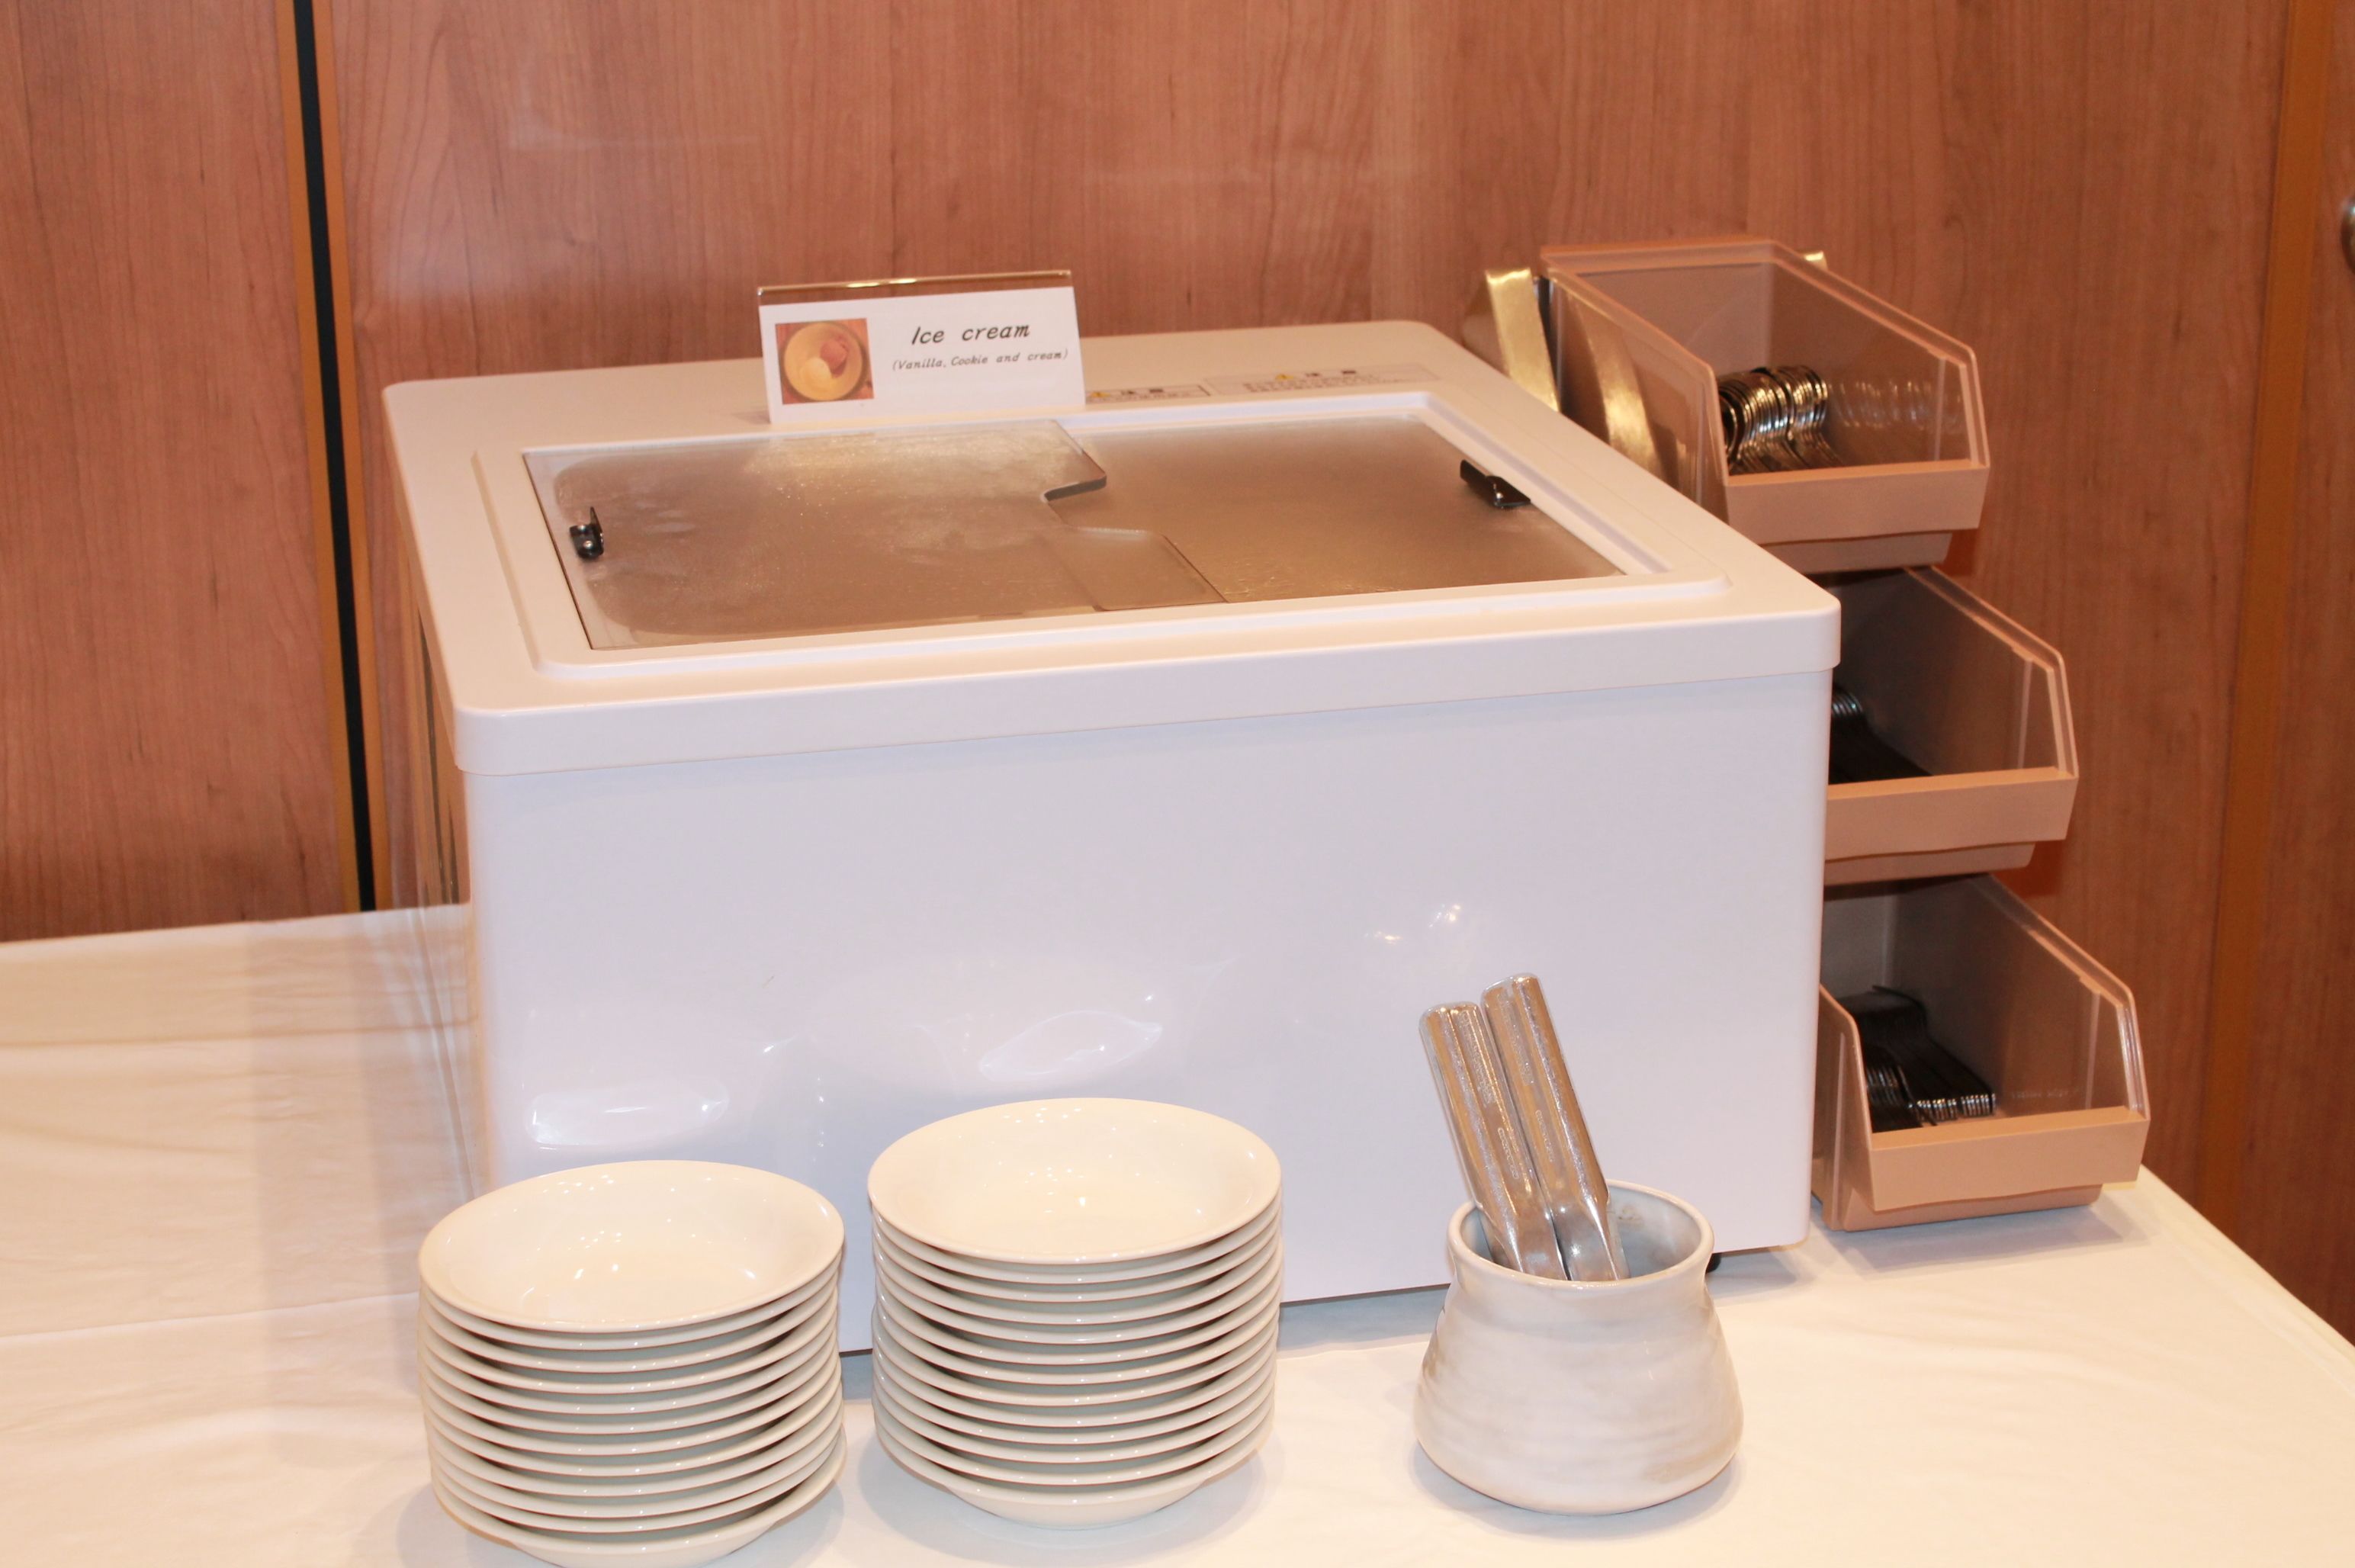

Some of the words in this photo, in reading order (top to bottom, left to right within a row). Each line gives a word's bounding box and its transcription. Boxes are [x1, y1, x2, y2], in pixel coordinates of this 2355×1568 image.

[911, 326, 944, 345] Ice
[962, 324, 1030, 342] cream
[996, 352, 1021, 363] and
[1027, 349, 1069, 361] cream)
